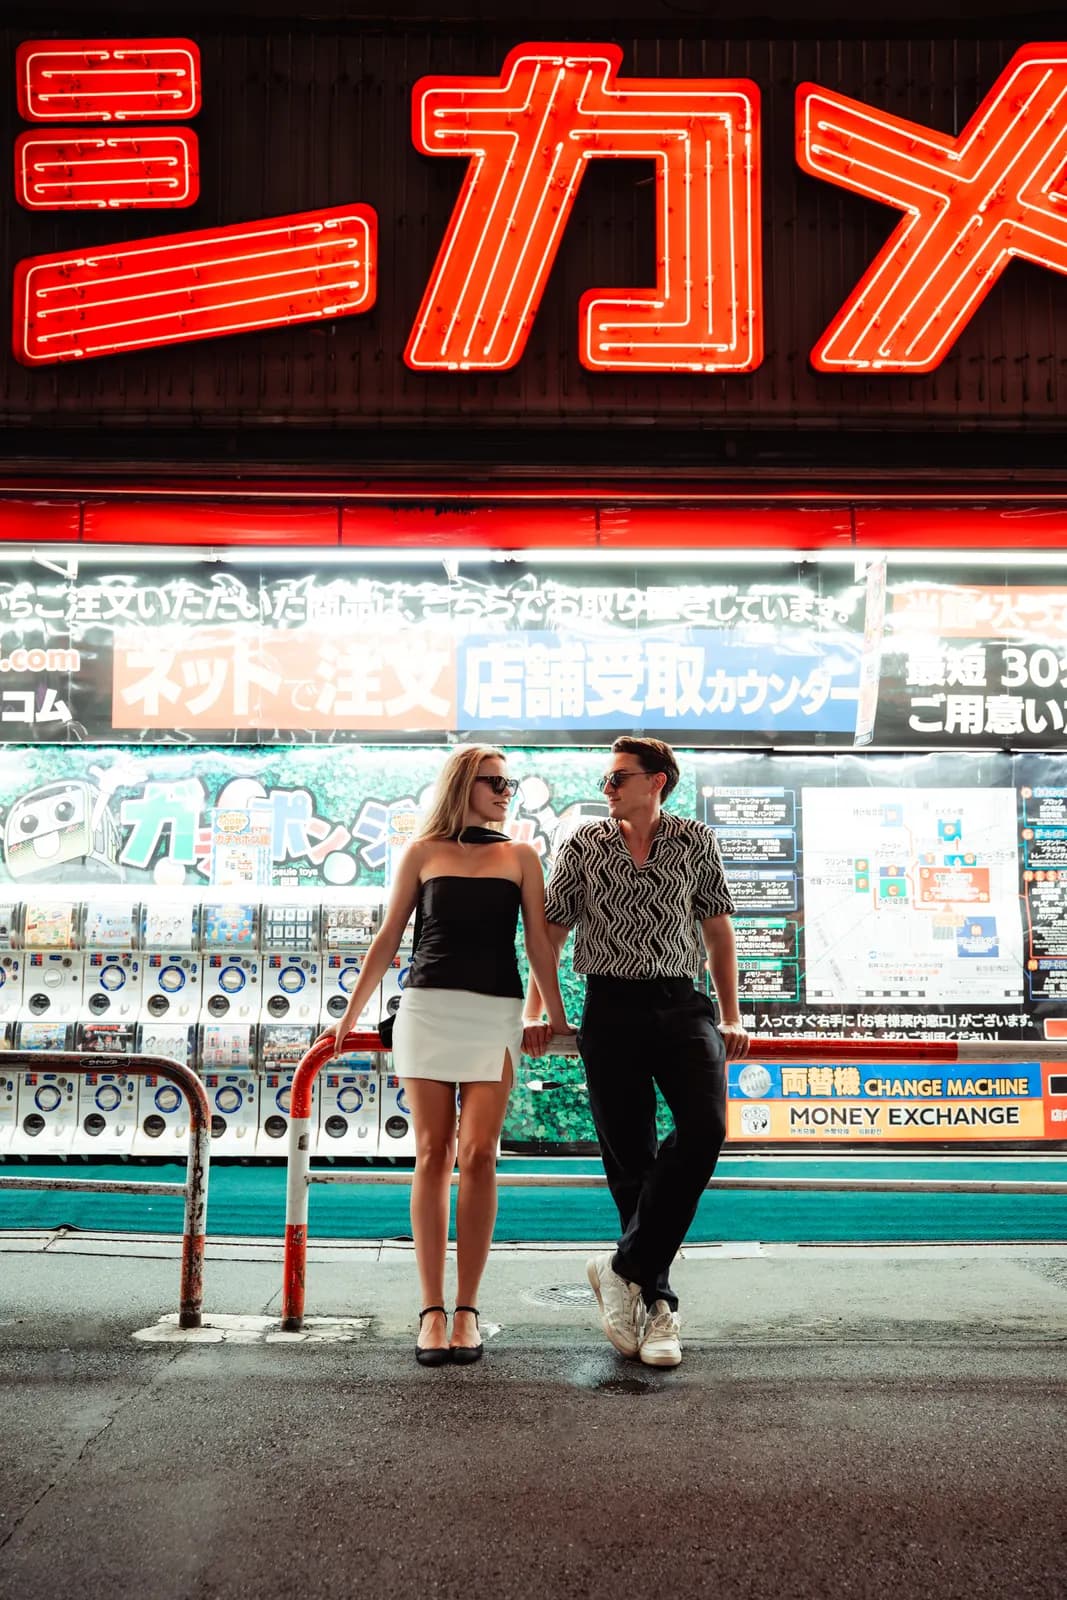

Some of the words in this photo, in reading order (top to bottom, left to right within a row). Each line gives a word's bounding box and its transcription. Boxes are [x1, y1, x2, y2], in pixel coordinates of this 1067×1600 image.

[120, 640, 452, 717] ネットで注文
[464, 644, 861, 718] 店舗受取カウンター
[1001, 648, 1067, 688] 30
[2, 688, 72, 722] コム
[908, 693, 1067, 734] ご用意い
[780, 1066, 861, 1097] 両替機
[864, 1079, 943, 1097] CHANGE
[946, 1078, 1030, 1097] MACHINE
[789, 1107, 881, 1126] MONEY
[888, 1106, 1020, 1126] EXCHANGE
